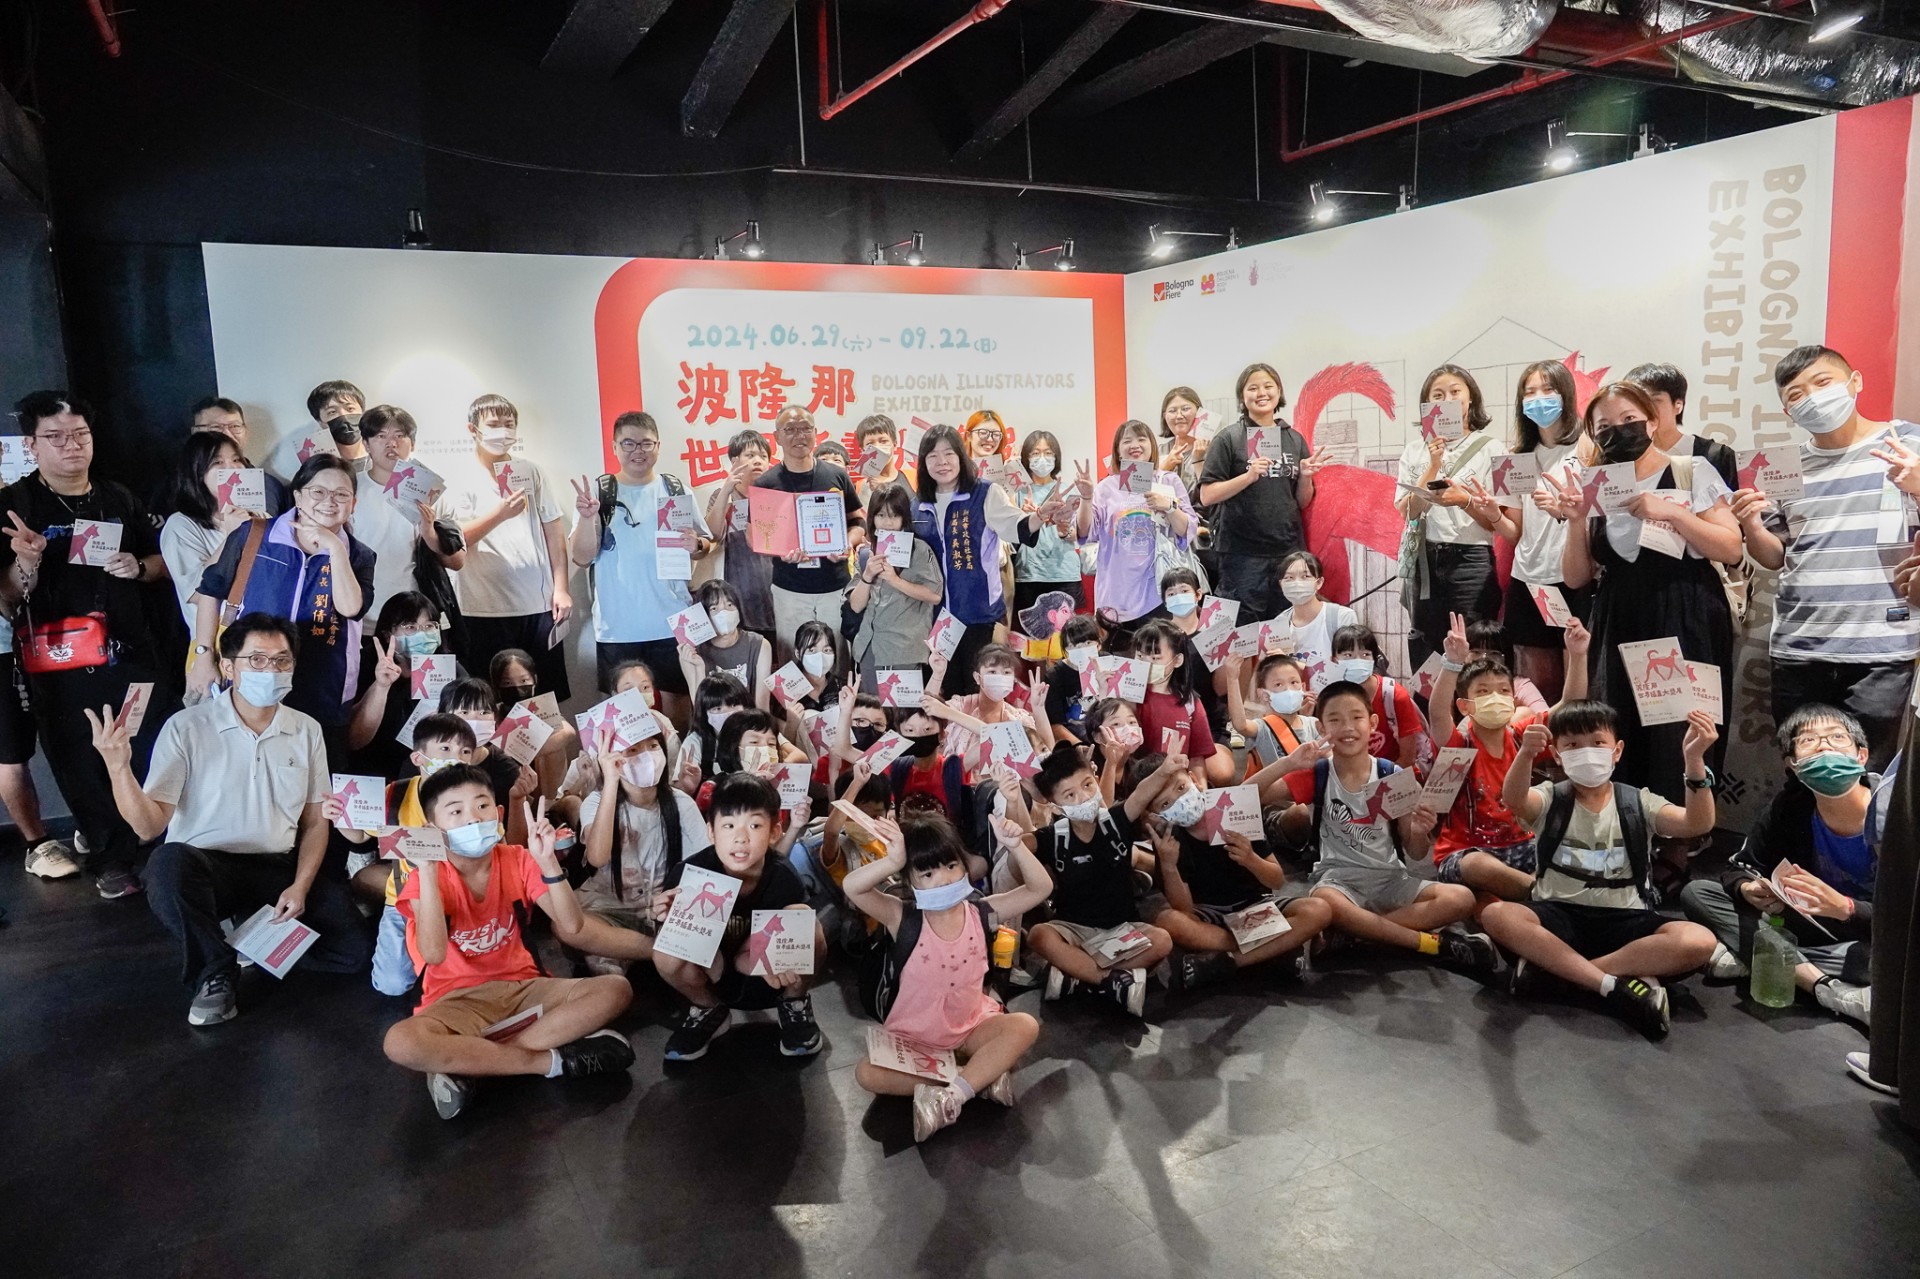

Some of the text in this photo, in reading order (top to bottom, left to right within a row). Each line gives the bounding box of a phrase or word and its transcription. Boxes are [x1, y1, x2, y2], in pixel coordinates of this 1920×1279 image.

[1753, 164, 1807, 383] BOLOGNA
[1164, 278, 1195, 292] Bologna
[1165, 290, 1181, 301] Fiere
[1700, 180, 1749, 448] EXHIBITIO
[871, 372, 1076, 392] BOLOGNA ILLUSTRATORS
[872, 394, 984, 414] EXHIBITION
